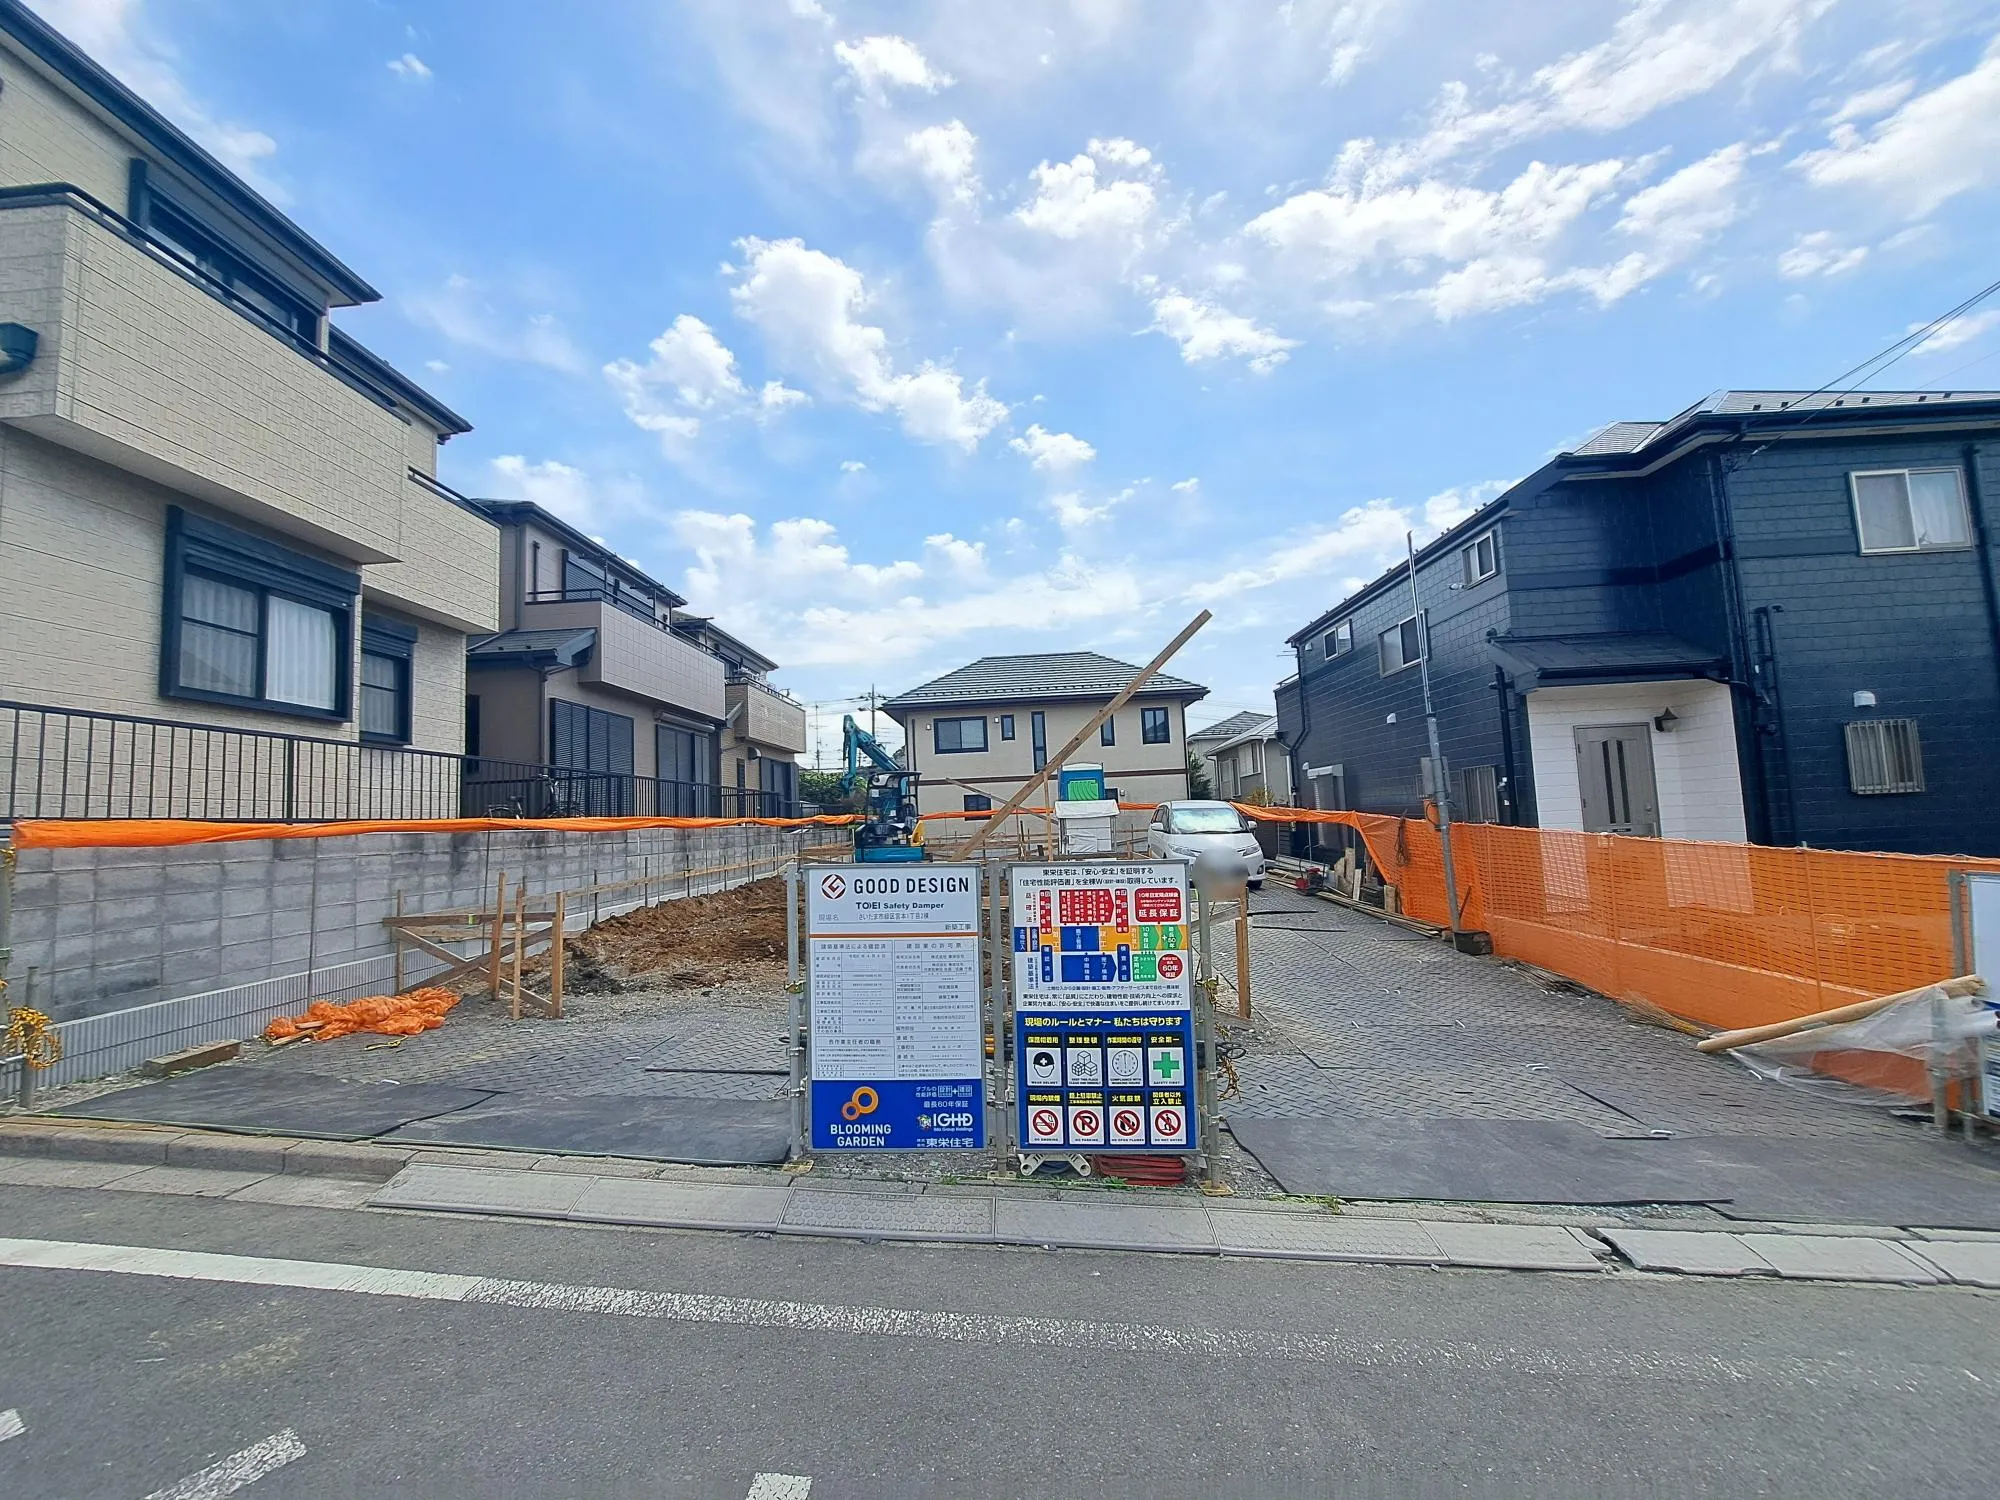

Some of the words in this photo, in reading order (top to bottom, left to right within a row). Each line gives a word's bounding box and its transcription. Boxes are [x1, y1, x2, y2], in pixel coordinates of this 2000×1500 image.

[854, 878, 899, 894] GOOD
[906, 877, 969, 893] DESIGN
[1139, 909, 1178, 917] 延長保証
[1024, 1018, 1111, 1027] 現場のルールとマナー
[1114, 1017, 1182, 1026] 私たちは守ります
[933, 1113, 973, 1126] IGHD
[830, 1124, 891, 1134] BLOOMING
[837, 1136, 885, 1146] GARDEN
[926, 1138, 973, 1147] 東栄住宅
